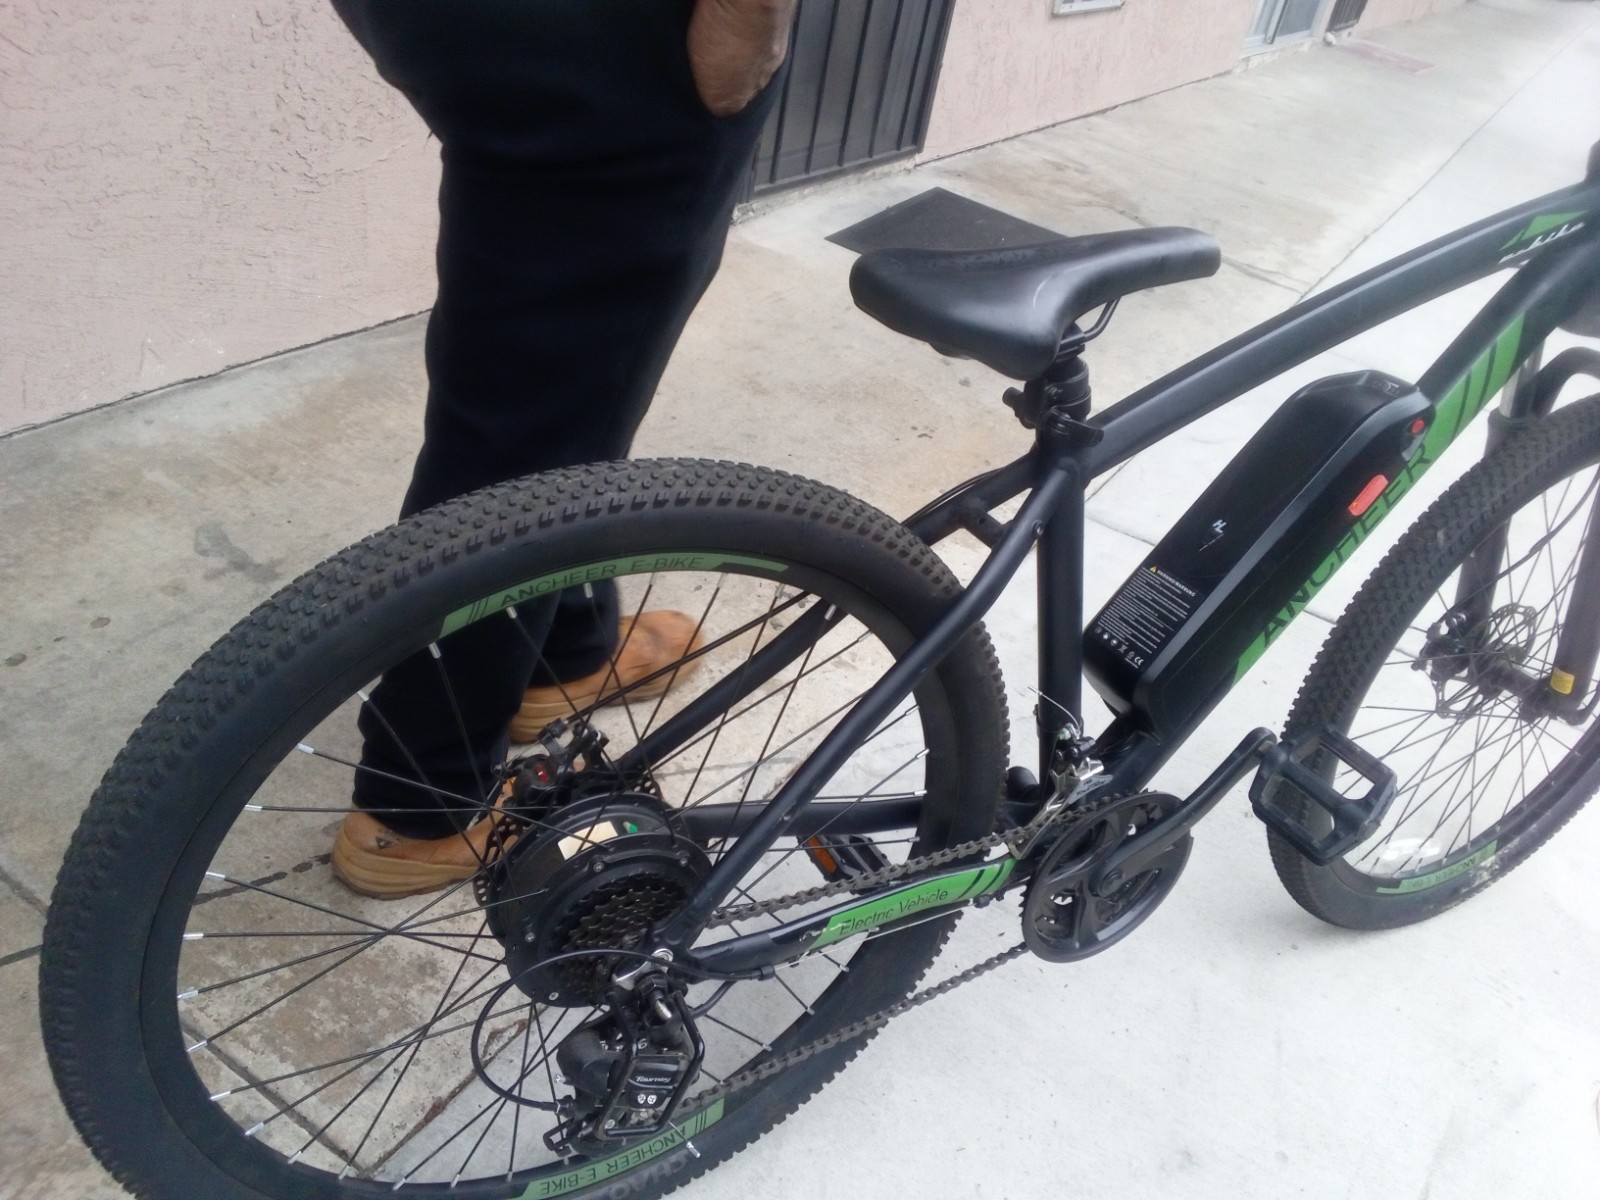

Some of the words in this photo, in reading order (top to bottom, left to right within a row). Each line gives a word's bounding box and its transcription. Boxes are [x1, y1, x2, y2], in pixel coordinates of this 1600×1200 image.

[501, 563, 616, 604] ANCHEER
[631, 556, 705, 572] E-BIKE
[839, 909, 894, 936] Electric
[898, 888, 949, 914] Vehicle
[635, 1075, 672, 1084] Tourney
[606, 1124, 688, 1174] ANCHEER
[540, 1167, 597, 1195] E-BIKE
